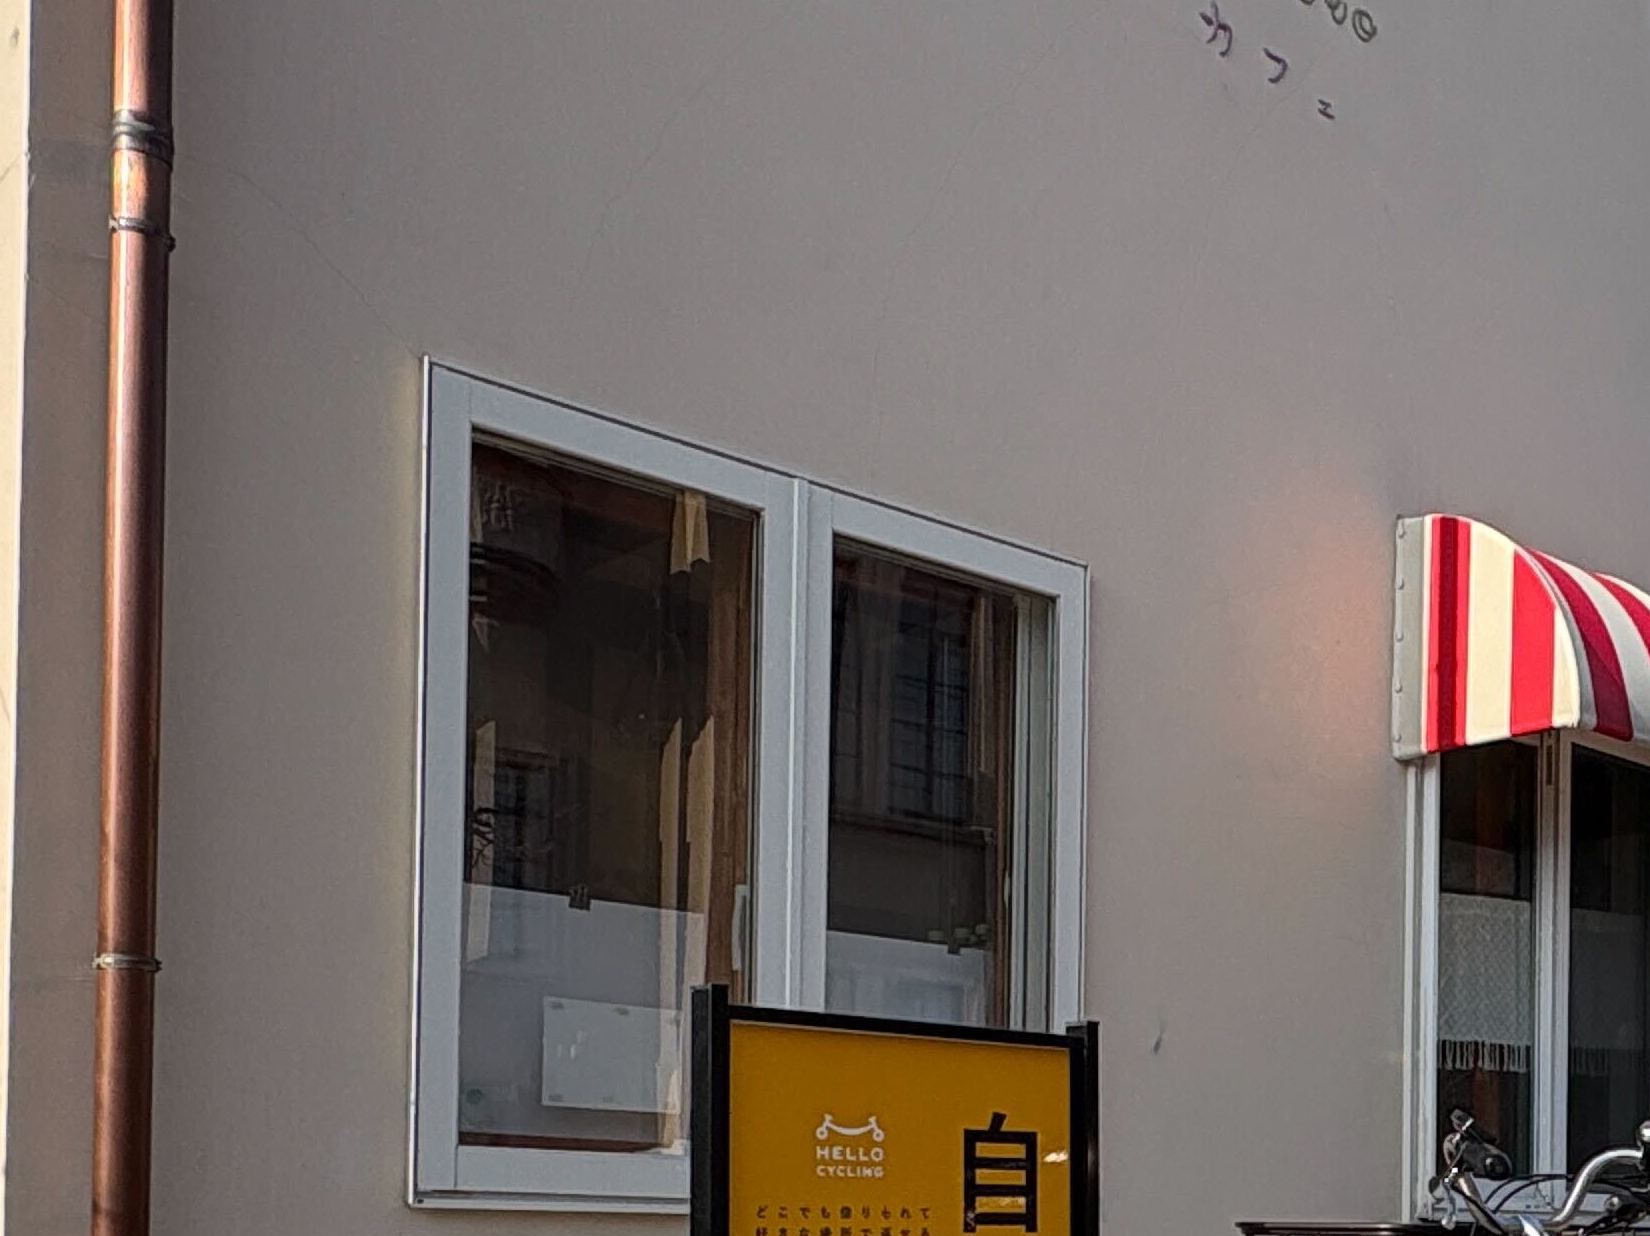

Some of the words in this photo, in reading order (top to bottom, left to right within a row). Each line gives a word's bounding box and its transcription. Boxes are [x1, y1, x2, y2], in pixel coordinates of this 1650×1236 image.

[1198, 1, 1336, 120] カフェ
[816, 1145, 884, 1162] HELLO
[816, 1166, 884, 1178] CYCLING
